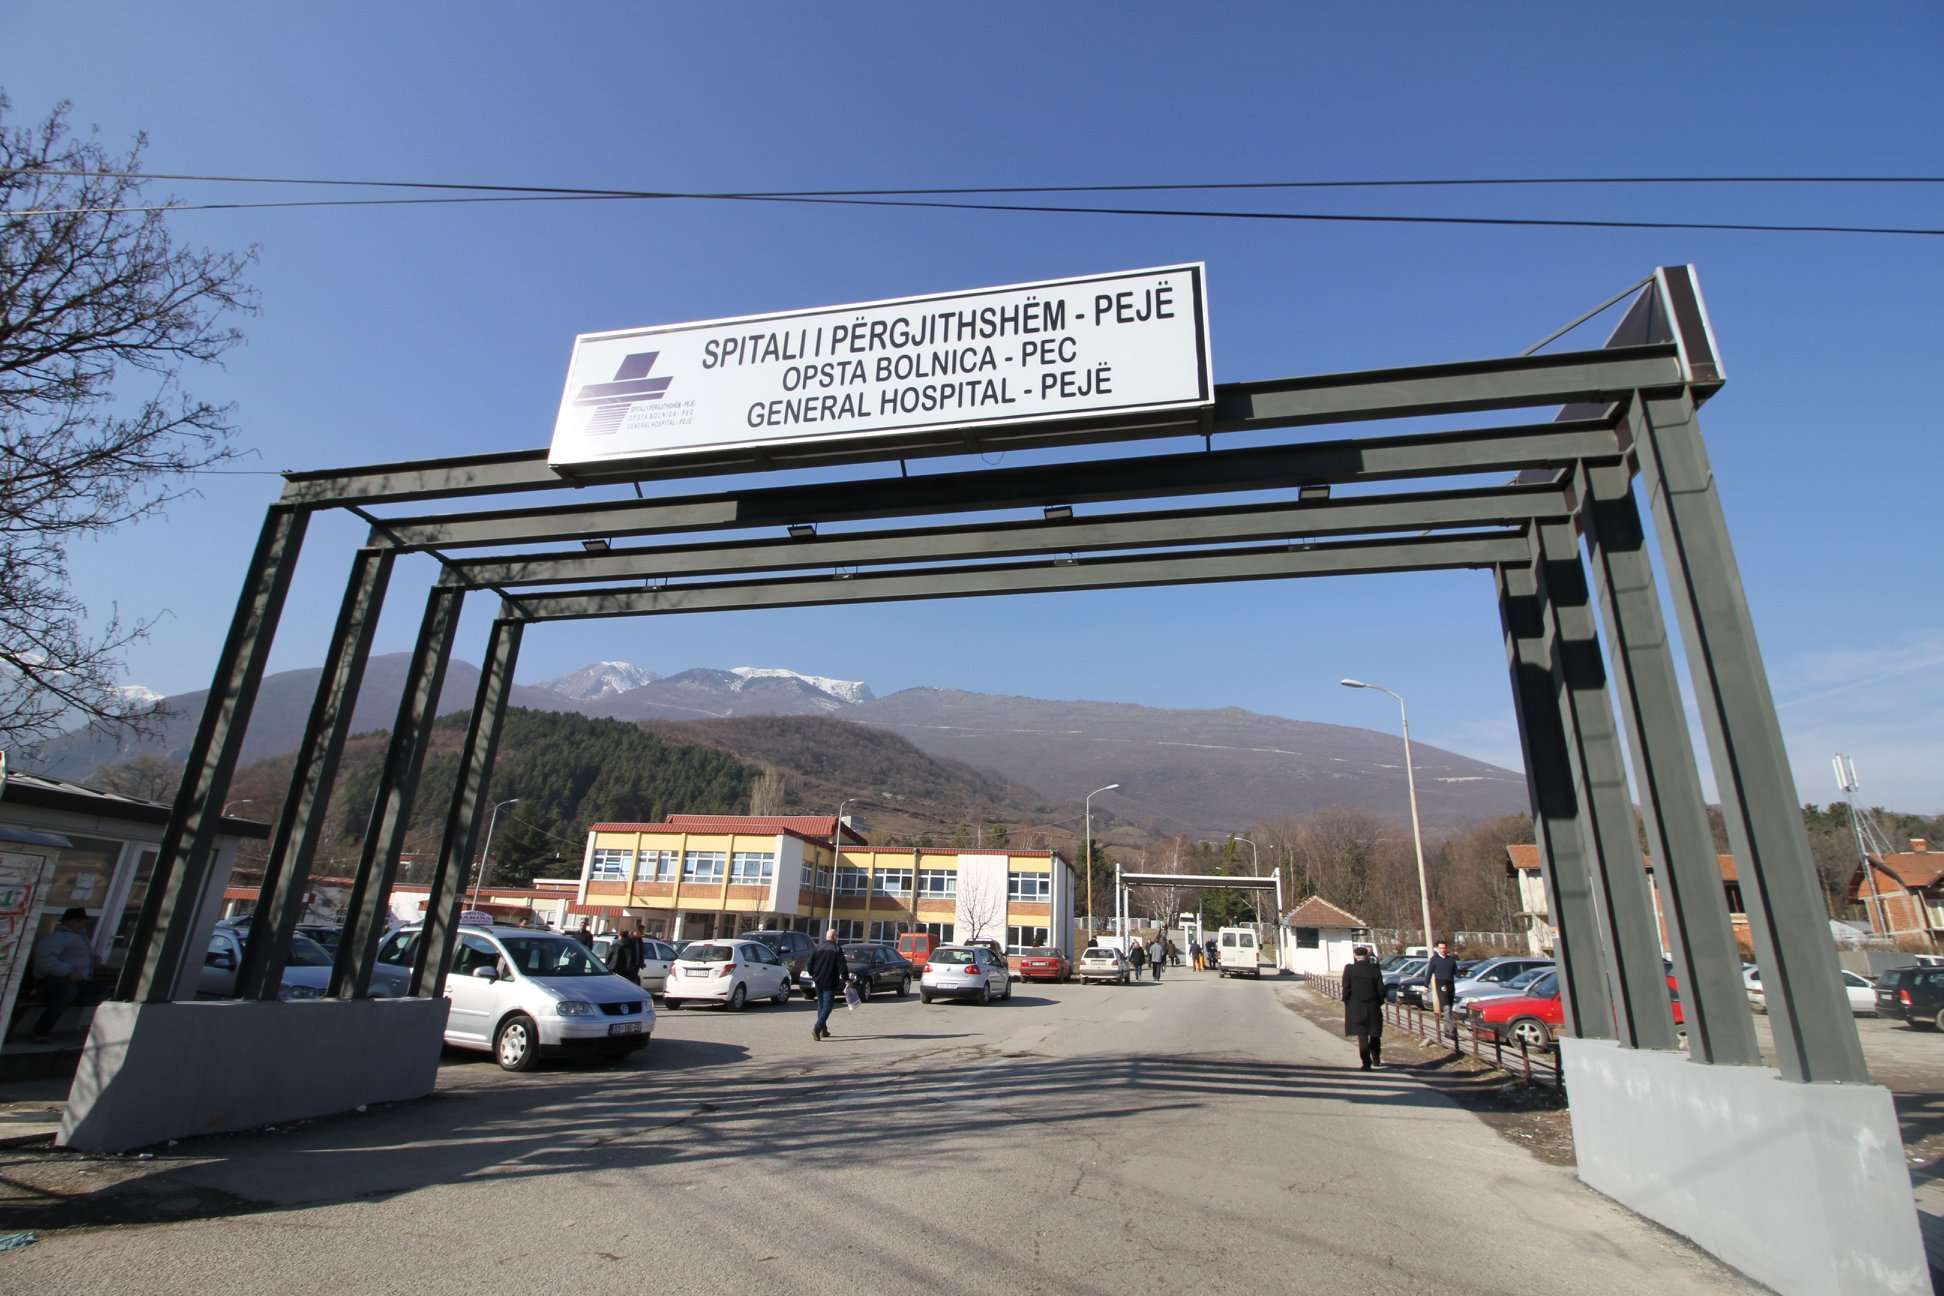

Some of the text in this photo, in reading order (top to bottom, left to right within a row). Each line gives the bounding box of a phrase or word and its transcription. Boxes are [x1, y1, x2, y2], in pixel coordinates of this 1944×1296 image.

[702, 329, 807, 370] SPITALI
[814, 327, 823, 358] I
[830, 296, 1066, 356] PËRGJITHSHËM
[1094, 280, 1175, 327] PEJË
[747, 391, 872, 428] GENERAL
[879, 377, 1017, 416] HOSPITAL
[1041, 361, 1113, 401] PEJË
[782, 359, 867, 392] OPSTA
[875, 345, 998, 383] BOLNICA
[1021, 336, 1077, 368] PEC
